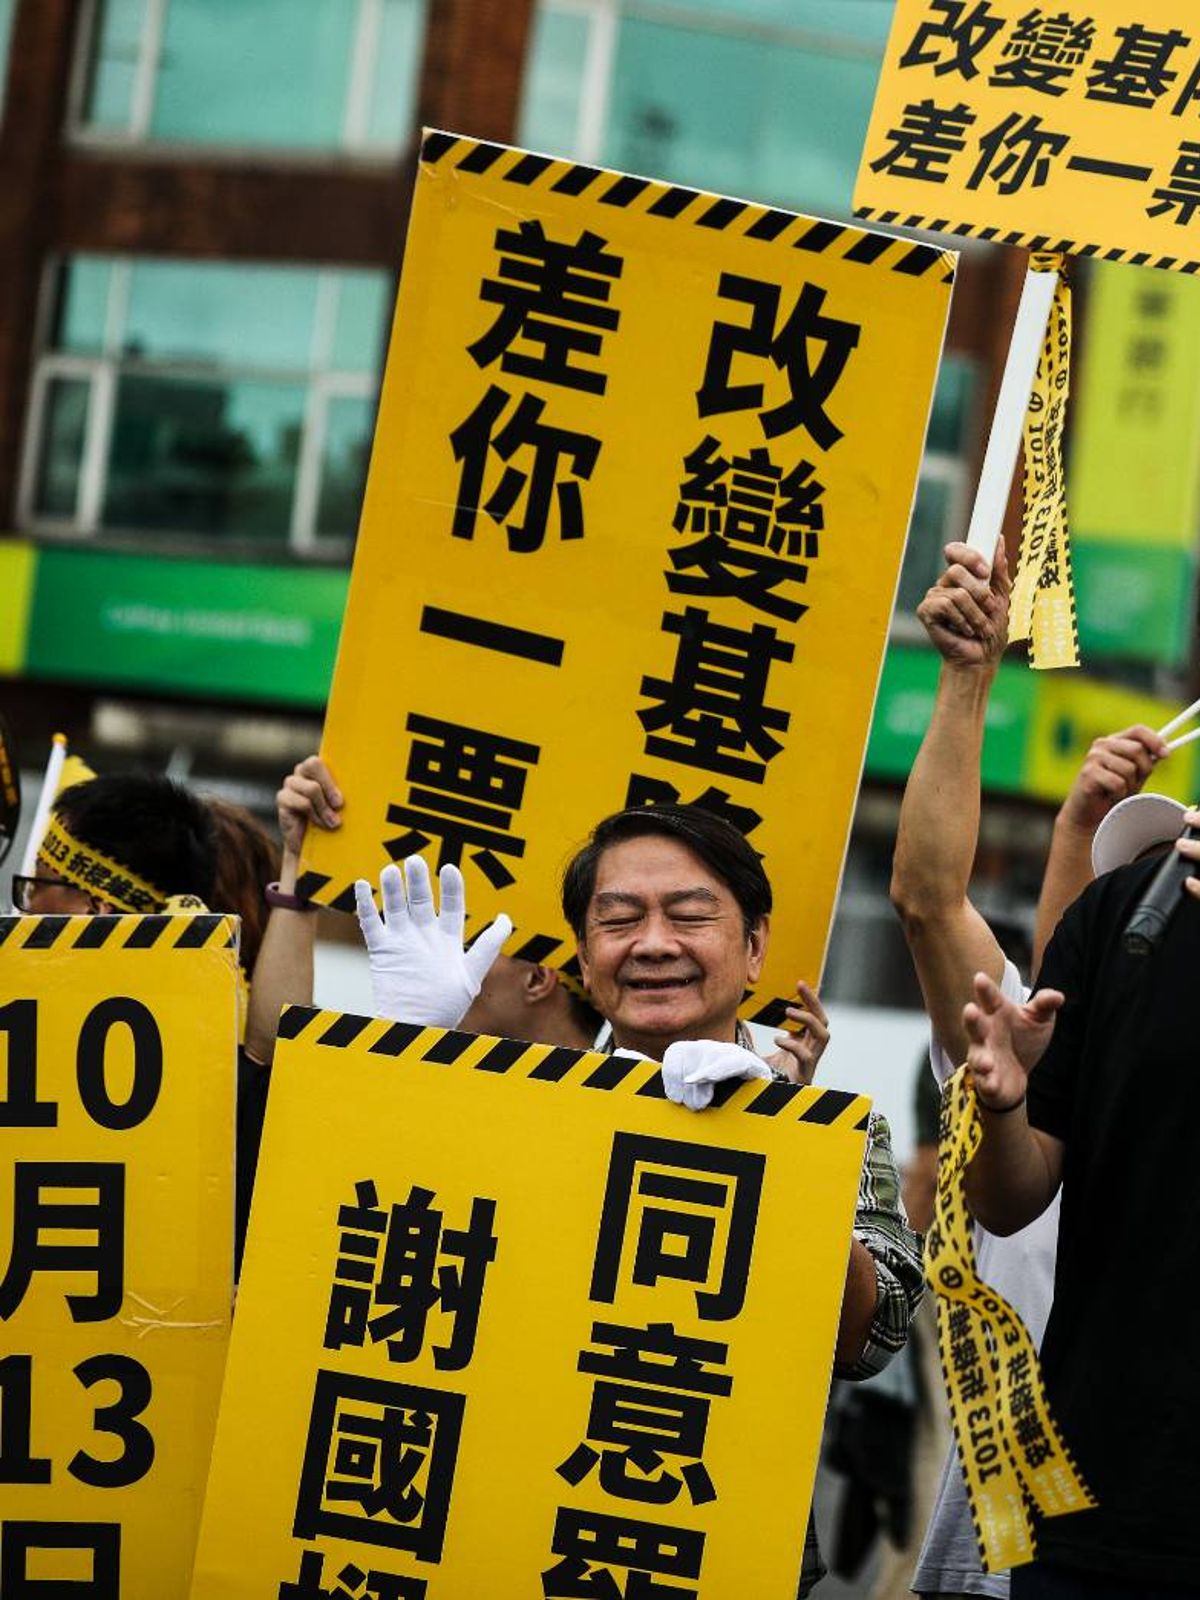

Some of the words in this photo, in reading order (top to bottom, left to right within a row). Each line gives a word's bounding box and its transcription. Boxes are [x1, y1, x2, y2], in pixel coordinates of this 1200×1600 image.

[384, 220, 624, 888] 差你一票
[278, 1179, 498, 1600] 謝國
